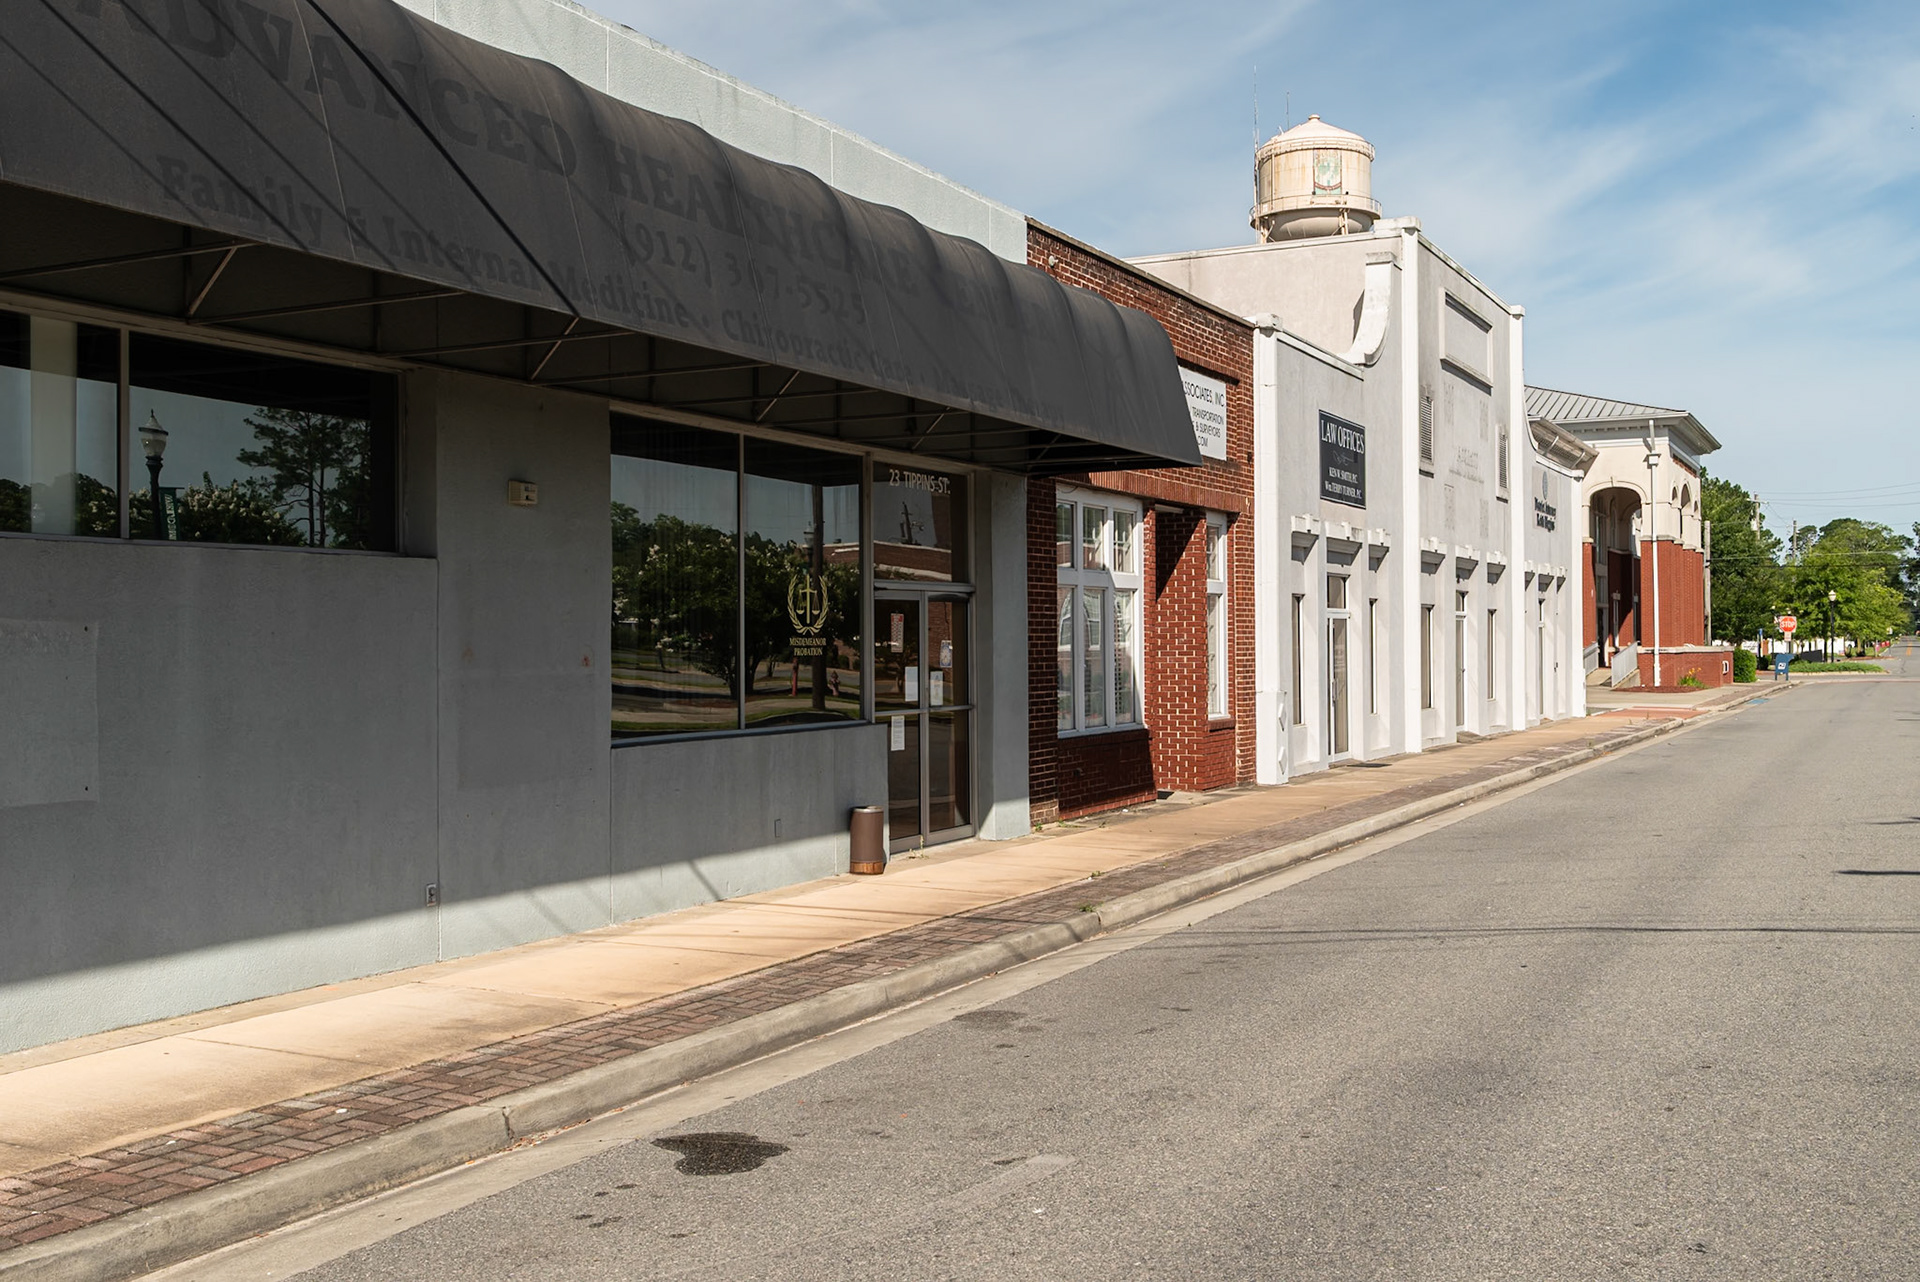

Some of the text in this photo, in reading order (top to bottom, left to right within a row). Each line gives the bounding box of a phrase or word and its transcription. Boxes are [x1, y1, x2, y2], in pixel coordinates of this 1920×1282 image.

[156, 154, 322, 247] Family
[382, 215, 542, 292] Internal
[547, 261, 689, 328] Medicine
[619, 209, 712, 289] (912)
[1182, 381, 1213, 405] SSOCIATES,
[1192, 406, 1224, 426] TRANSPORTATION
[1200, 421, 1221, 438] SURVEYORS
[1321, 419, 1365, 454] LAW OFFICES
[889, 469, 900, 487] 23
[903, 471, 935, 492] TIPPINS
[1780, 620, 1795, 628] STOP
[789, 637, 827, 646] MISDEMEANOR
[793, 647, 823, 656] PROBATION
